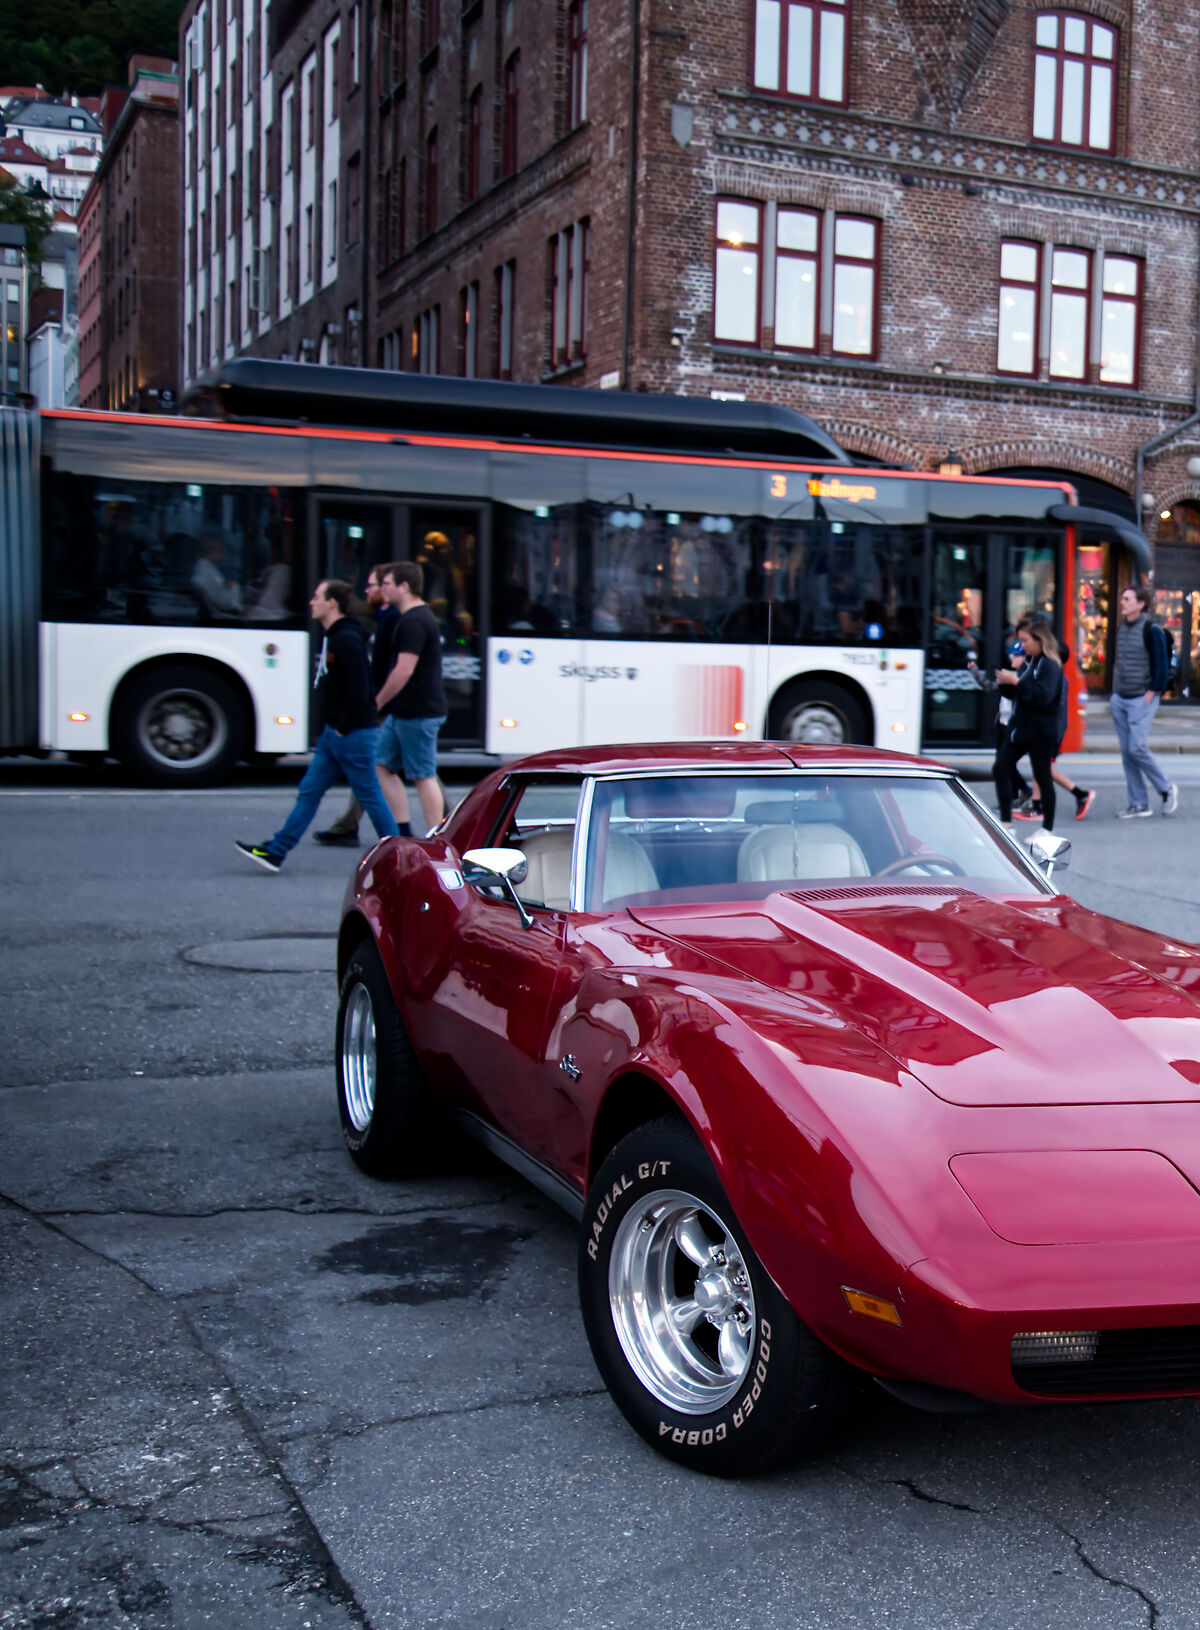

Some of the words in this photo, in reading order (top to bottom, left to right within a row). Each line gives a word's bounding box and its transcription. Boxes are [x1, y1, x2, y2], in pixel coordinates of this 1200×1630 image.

[770, 474, 787, 497] 3
[587, 1174, 633, 1260] RADIAL
[638, 1160, 671, 1179] G/T
[732, 1318, 772, 1429] COOPER
[658, 1421, 727, 1446] COBRA
